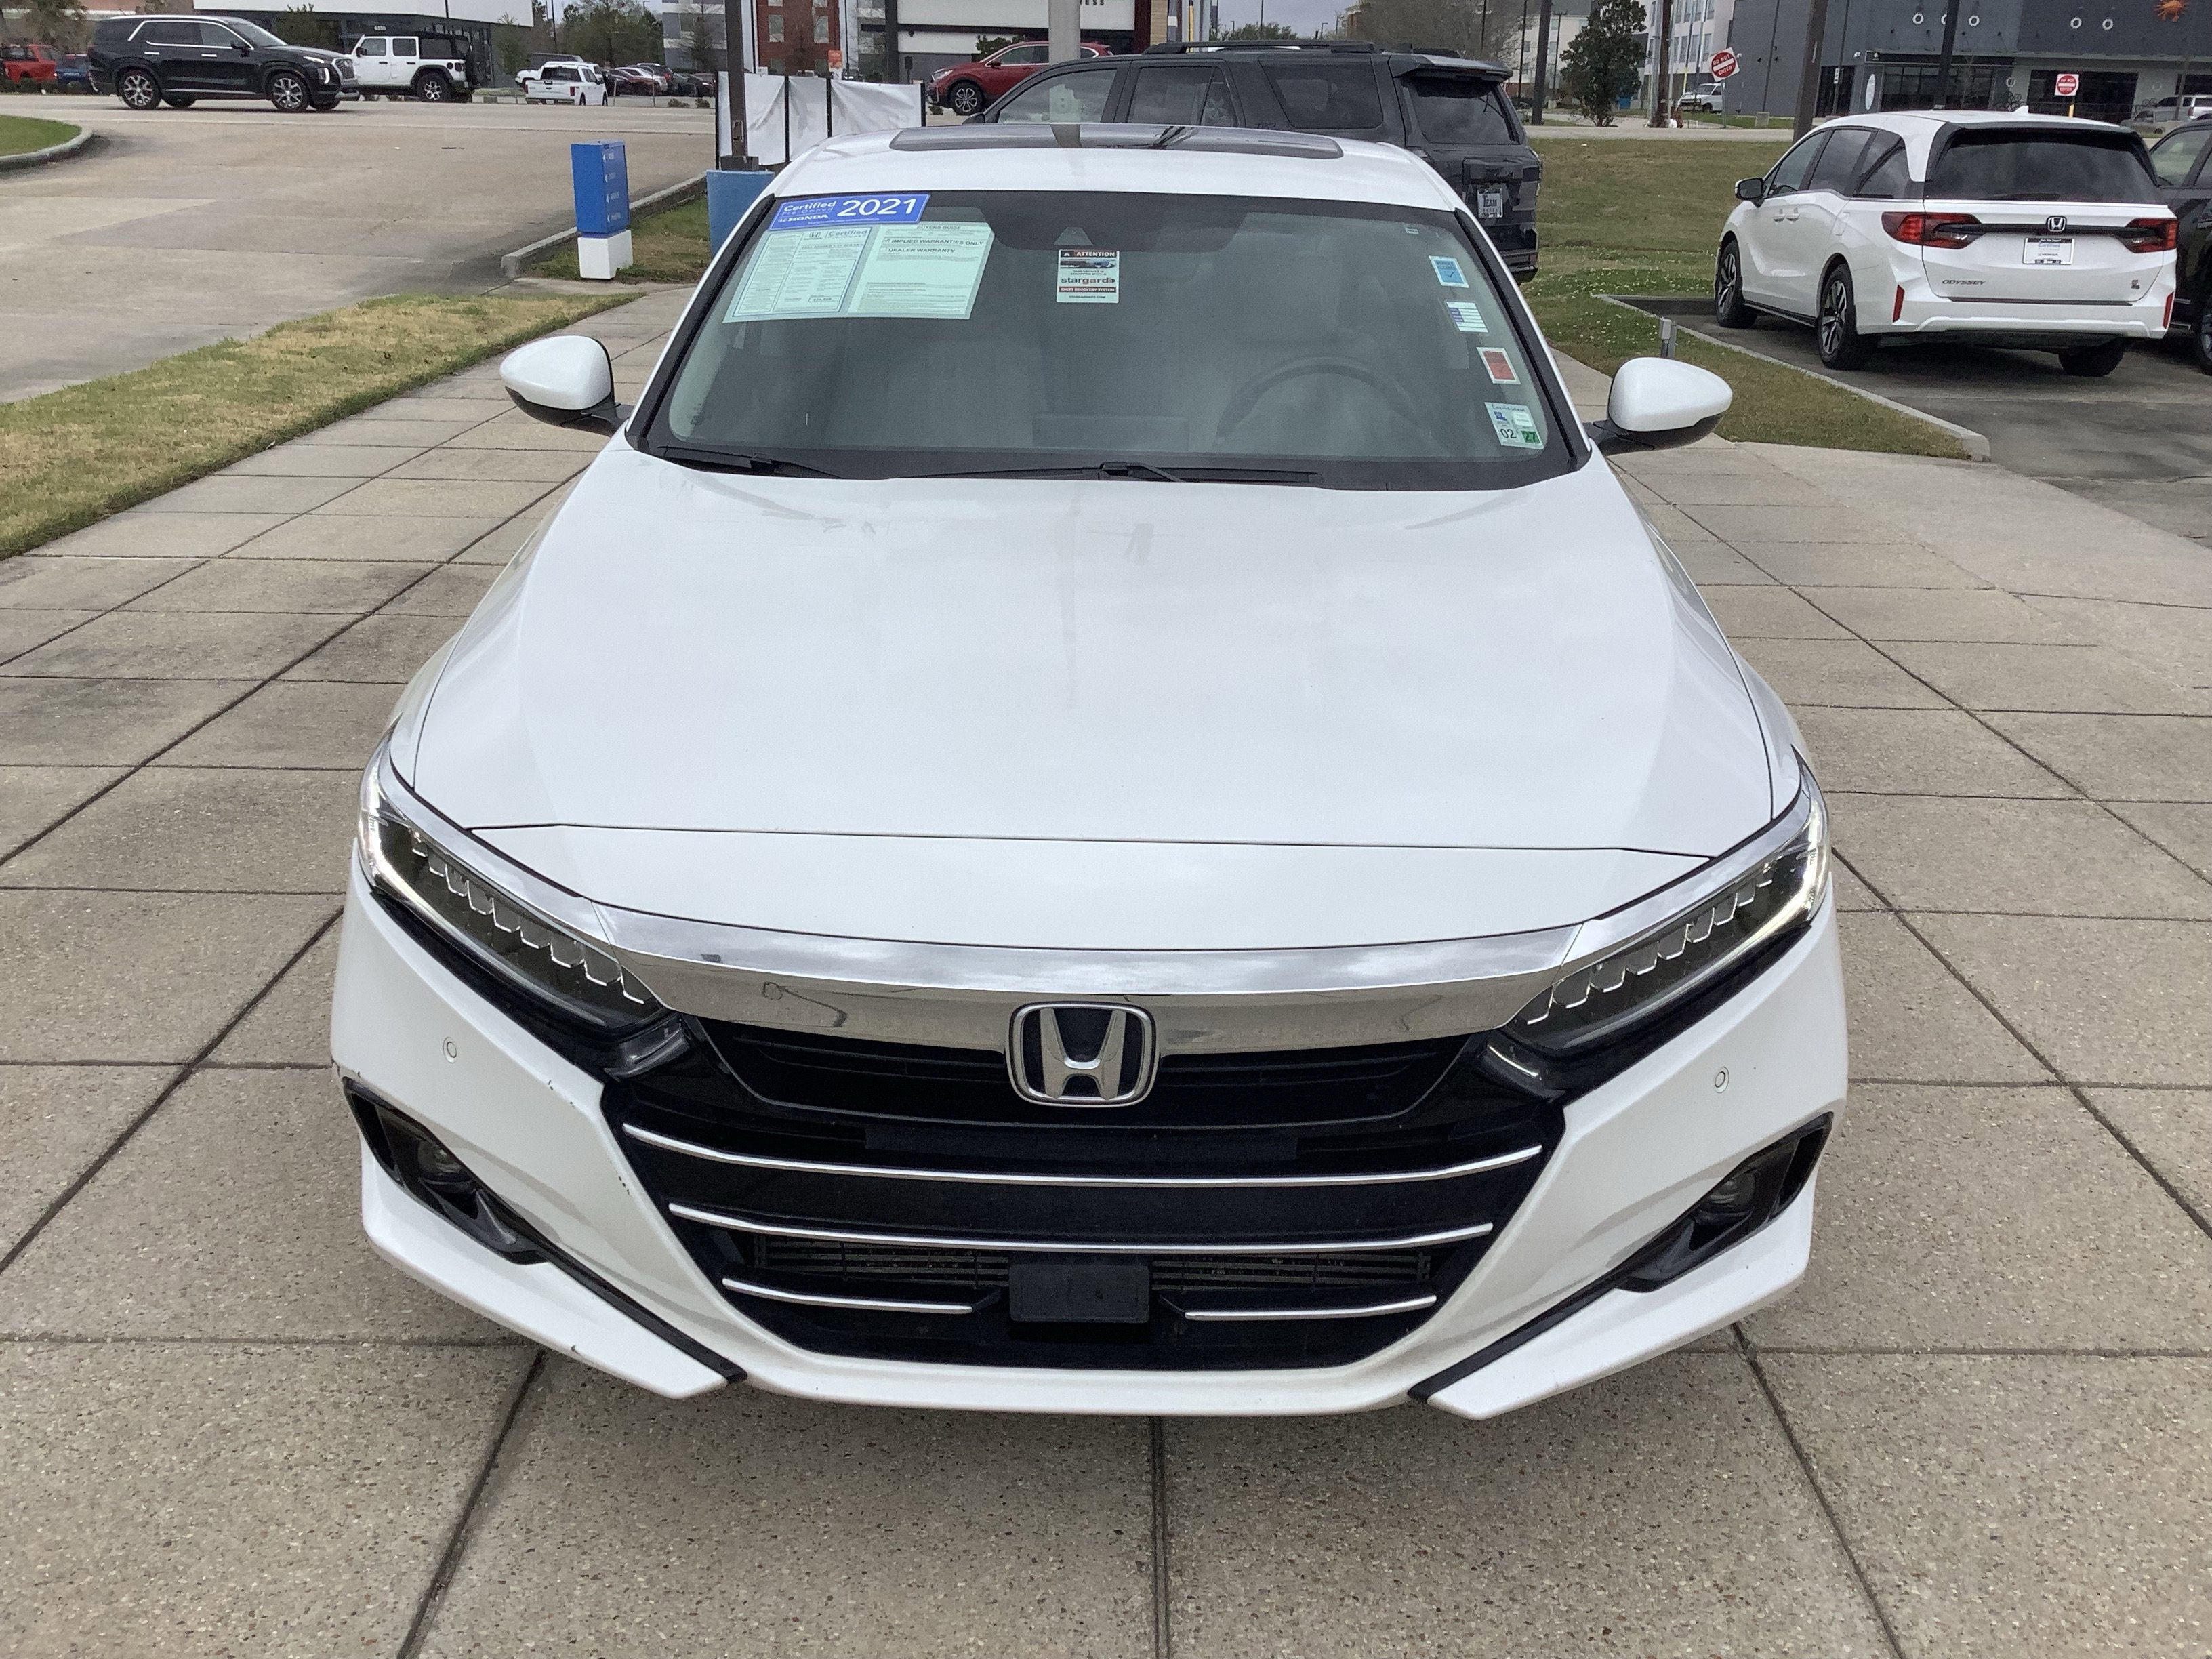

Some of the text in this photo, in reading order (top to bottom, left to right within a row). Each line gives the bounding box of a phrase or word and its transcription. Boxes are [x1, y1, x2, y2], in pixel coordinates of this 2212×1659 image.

[1718, 65, 1732, 75] ENTER
[781, 207, 834, 216] Pre-Owned
[783, 201, 836, 212] Certified
[837, 198, 917, 216] 2021
[787, 213, 828, 222] HONDA
[1500, 428, 1536, 443] 02 27
